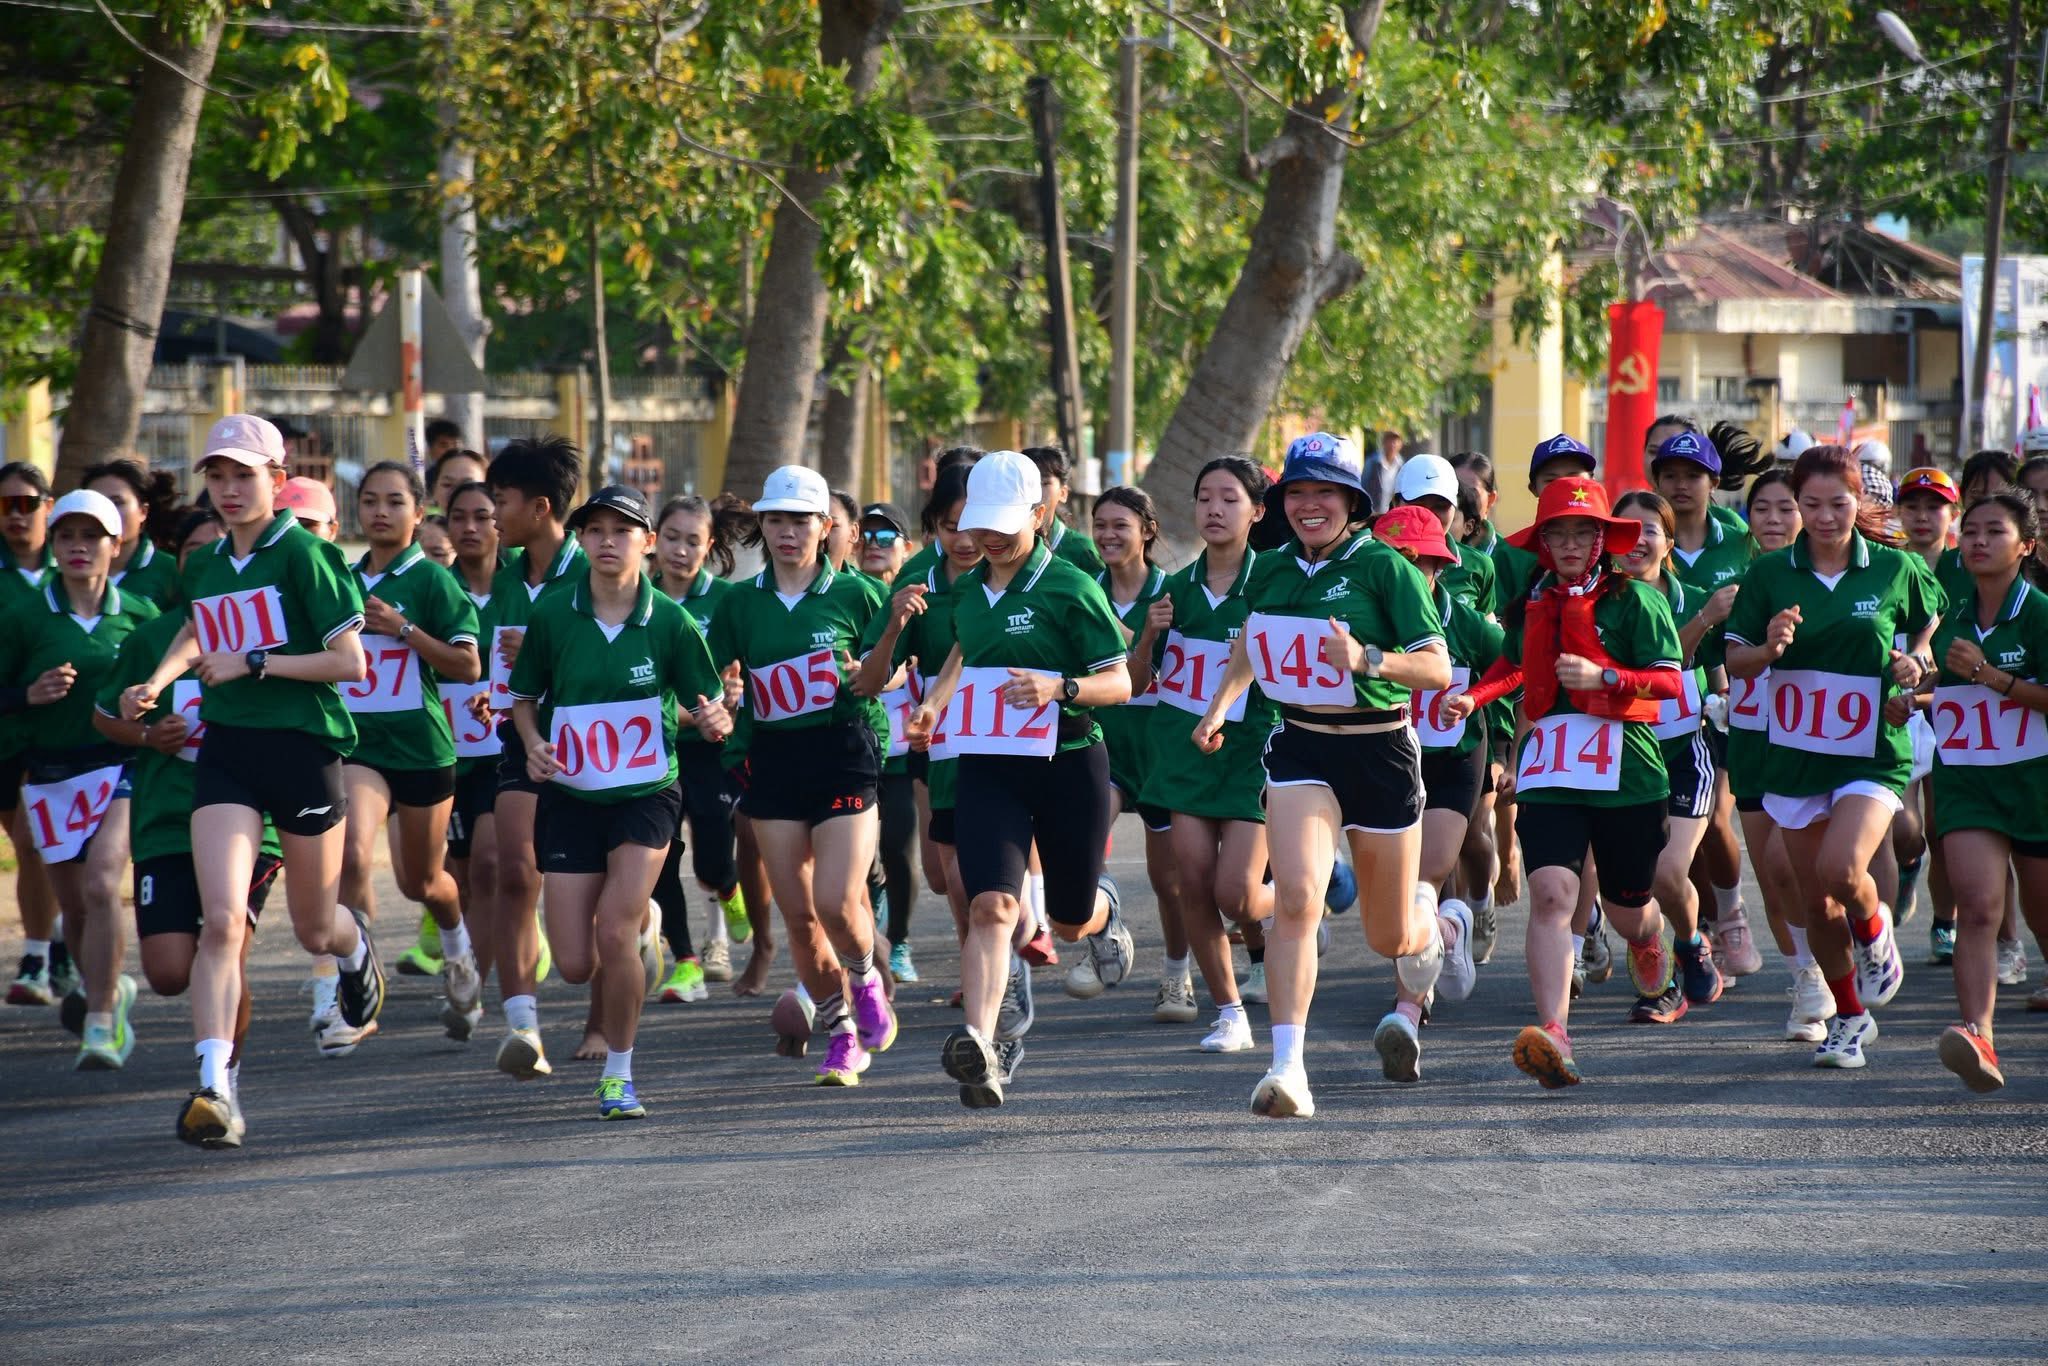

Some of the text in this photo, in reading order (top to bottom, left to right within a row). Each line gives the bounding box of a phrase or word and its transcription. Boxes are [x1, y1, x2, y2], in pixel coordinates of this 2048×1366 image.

[1007, 613, 1030, 626] TTC
[1855, 600, 1877, 611] TTC
[812, 632, 833, 643] TTC
[1228, 627, 1241, 637] TT
[2000, 651, 2022, 663] TTC
[630, 664, 652, 678] TTC
[751, 651, 839, 720] 005
[1161, 644, 1241, 703] 21
[1253, 631, 1345, 689] 145
[1774, 683, 1872, 741] 019
[1935, 699, 2031, 751] 217
[556, 715, 657, 777] 002
[1521, 722, 1613, 776] 214
